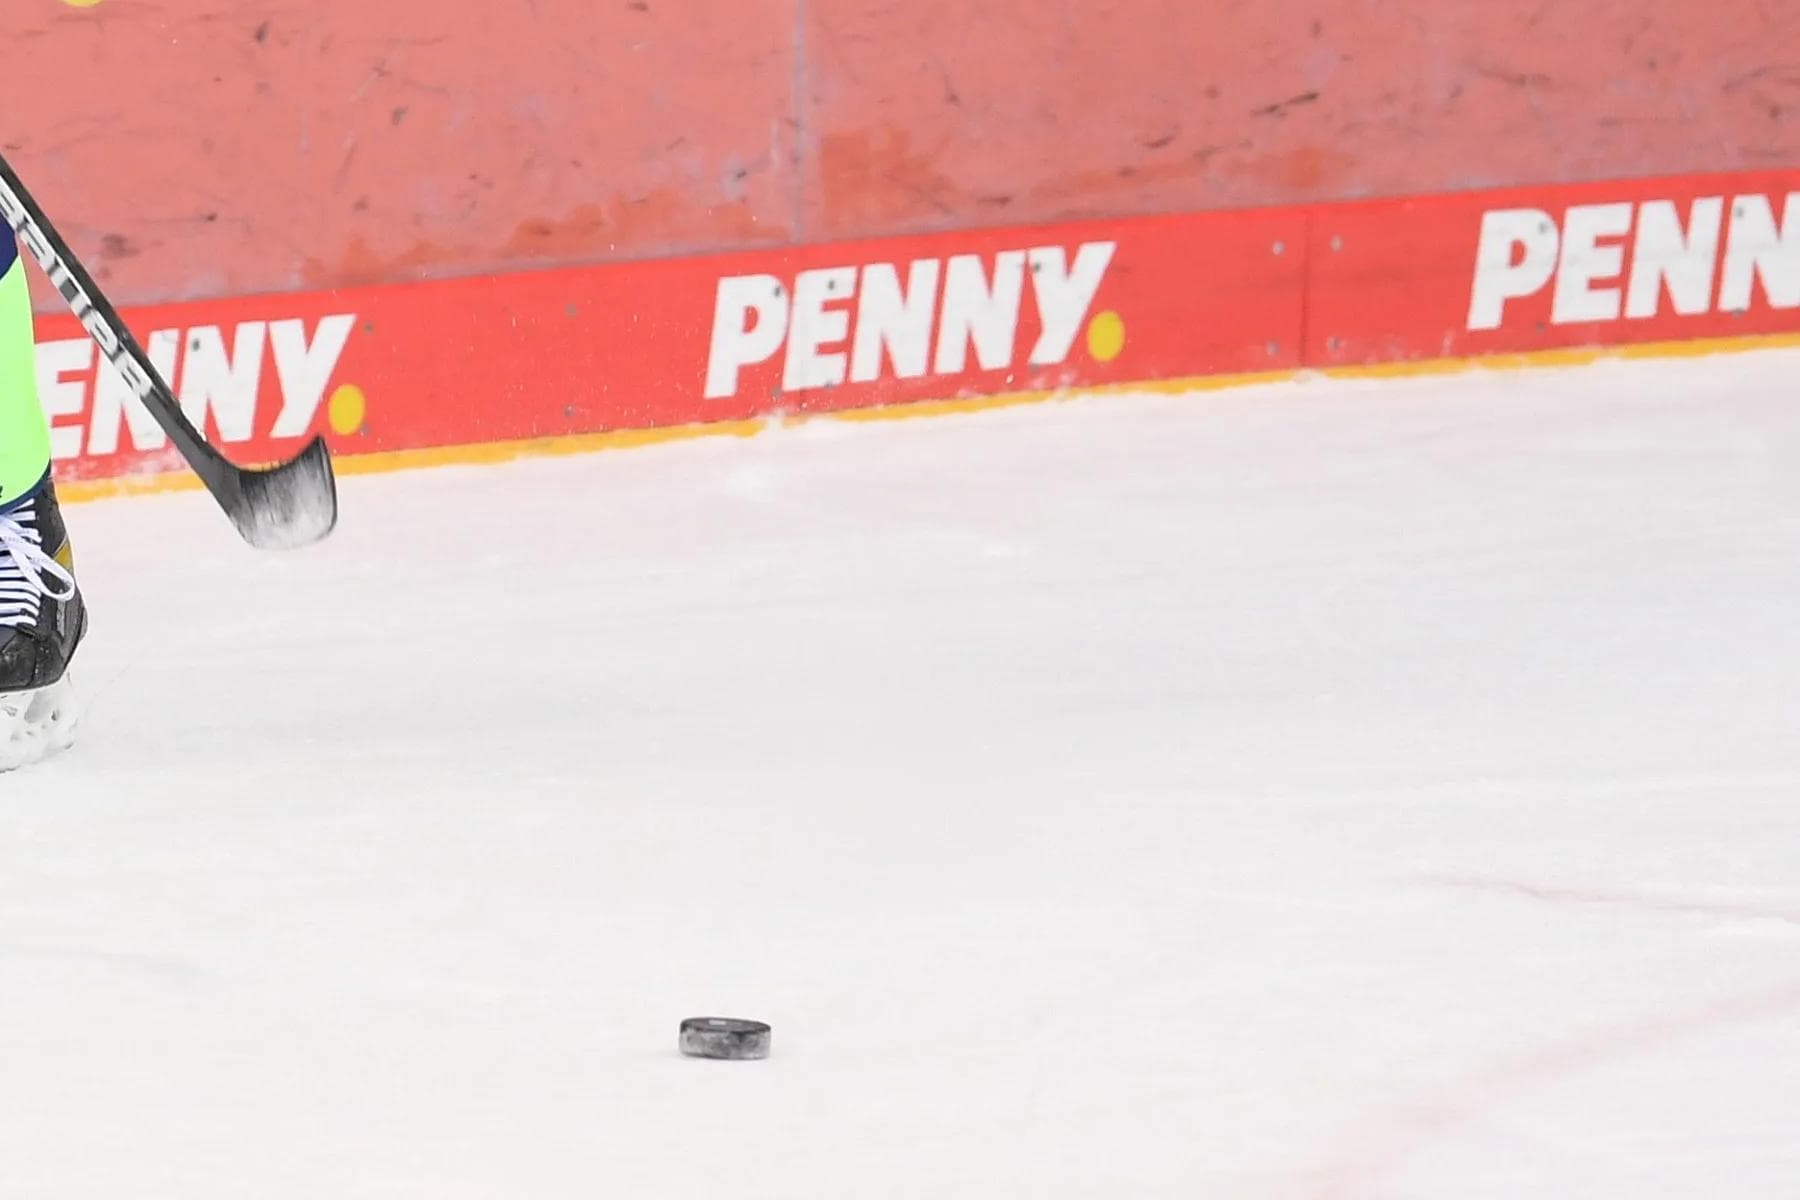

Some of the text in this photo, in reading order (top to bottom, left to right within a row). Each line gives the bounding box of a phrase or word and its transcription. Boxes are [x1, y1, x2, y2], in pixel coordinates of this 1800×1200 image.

[705, 241, 1116, 399] PENNY
[1466, 191, 1800, 330] PENN
[32, 313, 357, 461] ENNY
